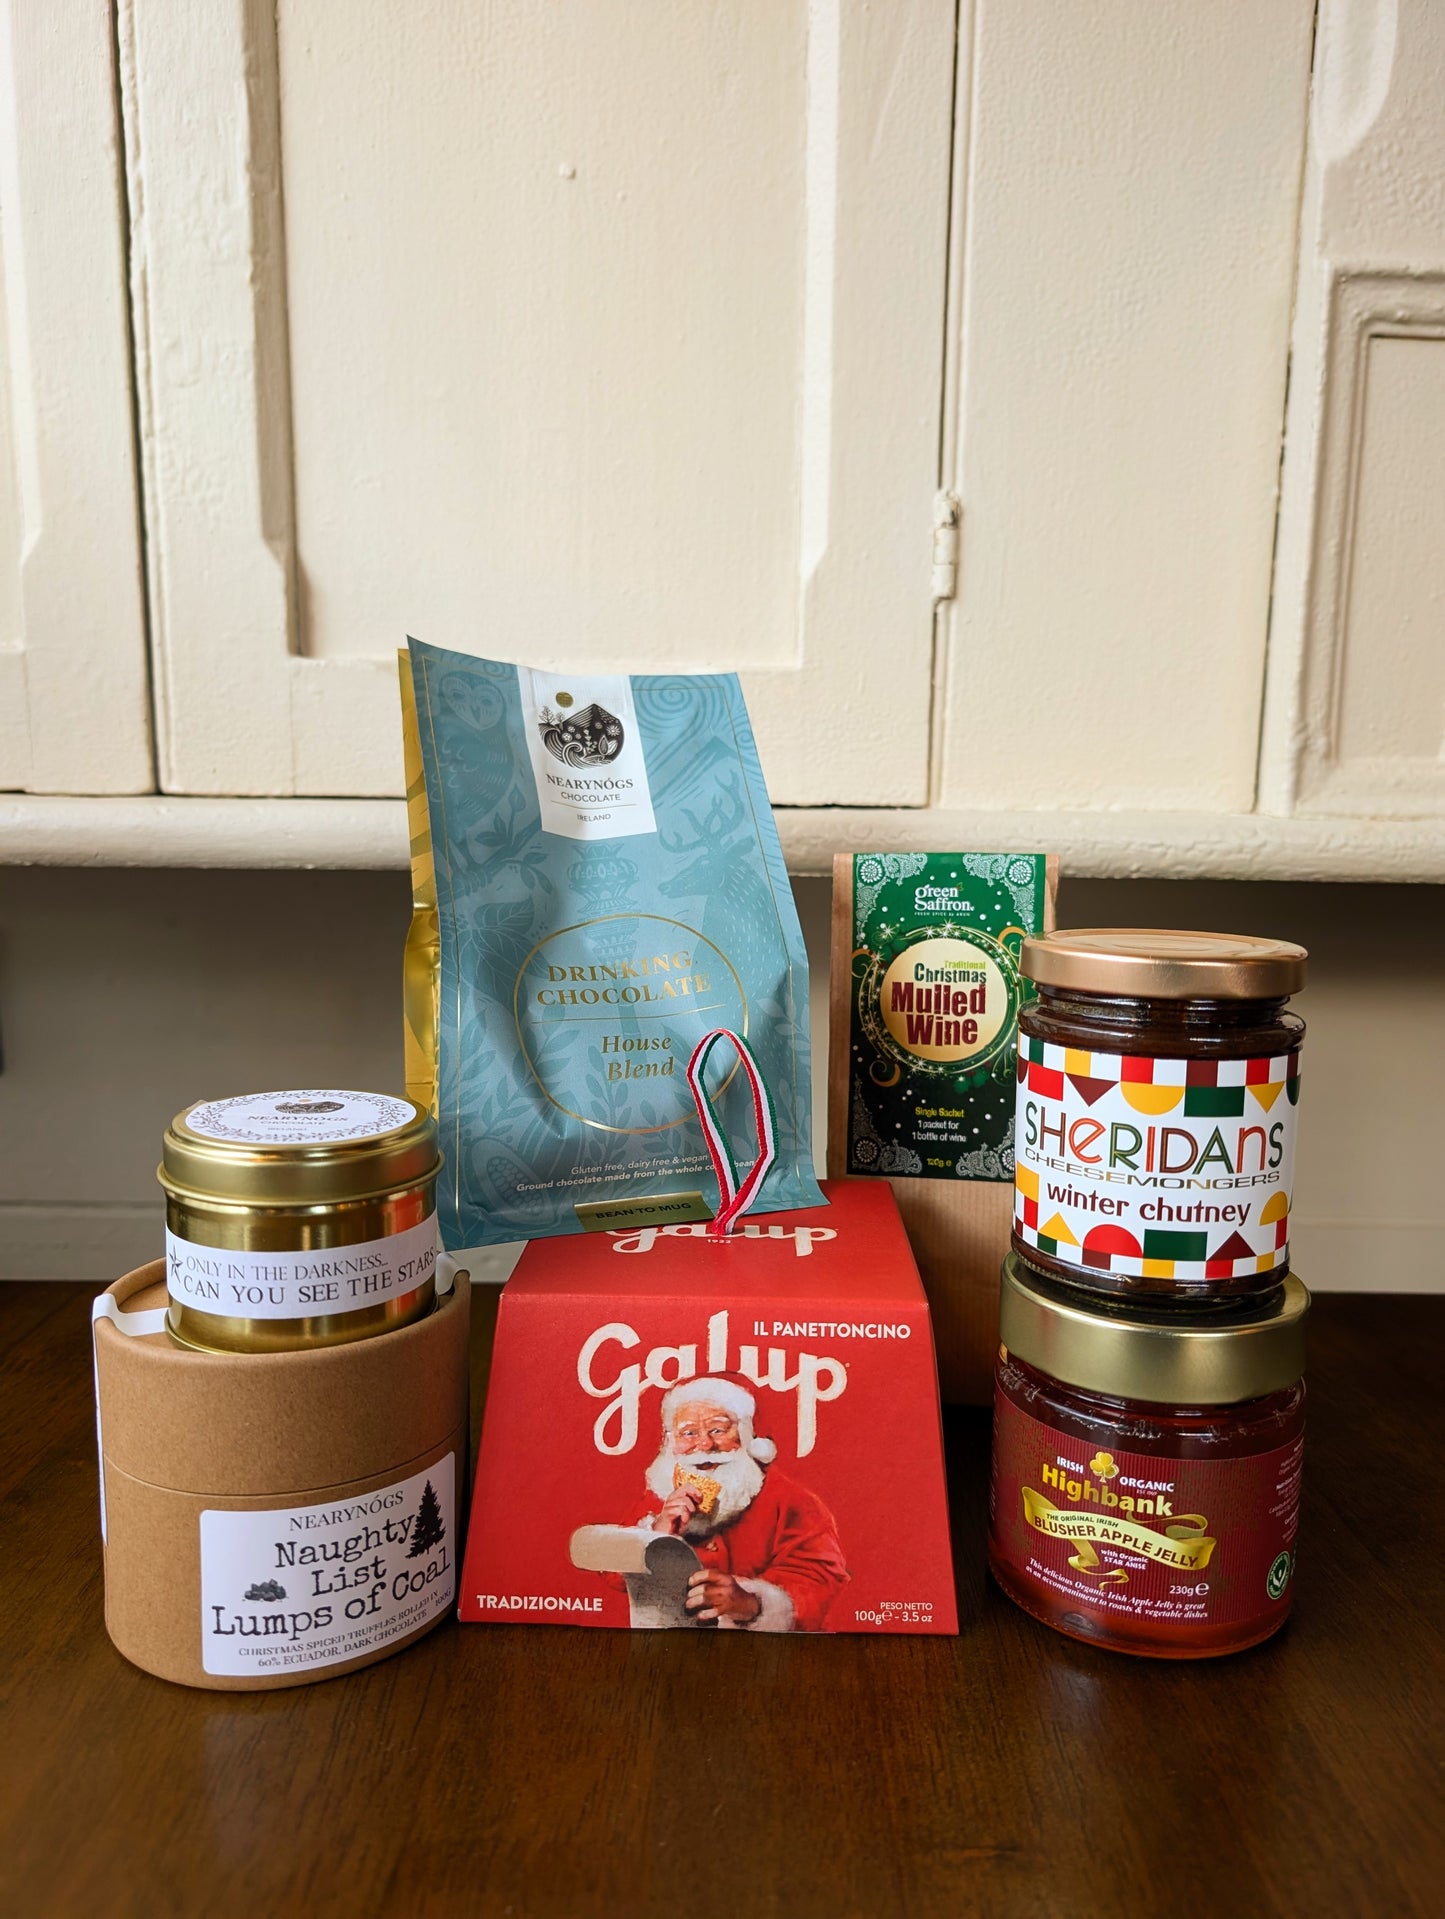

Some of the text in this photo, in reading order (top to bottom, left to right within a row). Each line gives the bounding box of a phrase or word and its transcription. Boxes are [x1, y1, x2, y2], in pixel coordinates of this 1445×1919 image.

[545, 773, 634, 791] NEARYNÓGS
[561, 791, 621, 803] CHOCOLATE
[576, 813, 612, 822] IRELAND
[914, 884, 959, 899] green
[547, 950, 692, 983] DRINKING
[914, 963, 987, 984] Christmas
[944, 960, 986, 969] Traditional
[537, 972, 712, 1007] CHOCOLATE
[891, 981, 986, 1017] Mulled
[906, 1014, 978, 1046] Wine
[601, 1033, 673, 1054] House
[607, 1056, 675, 1082] Blend
[915, 1106, 965, 1118] Single Sachet
[918, 1120, 960, 1129] 1 packet for
[912, 1131, 967, 1142] 1 bottle of wine
[571, 1155, 708, 1175] Gluten free, dairy free & vegan
[1025, 1147, 1280, 1189] CHEESEMONGERS
[516, 1180, 553, 1192] Ground
[556, 1175, 603, 1188] chocolate
[604, 1172, 631, 1181] made
[633, 1169, 656, 1179] from
[657, 1167, 674, 1177] the
[675, 1165, 704, 1175] whole
[596, 1202, 692, 1219] BEAN TO MUG
[1047, 1183, 1251, 1226] winter chutney
[183, 1247, 435, 1305] CAN YOU SEE THE STARS
[186, 1255, 222, 1279] ONLY
[228, 1264, 245, 1280] IN
[251, 1265, 288, 1281] THE
[753, 1321, 912, 1340] IL PANETTONCINO
[577, 1310, 848, 1458] Galup
[1057, 1456, 1175, 1492] IRISH ORGANIC
[1042, 1463, 1173, 1517] Highbank
[289, 1491, 404, 1531] NEARYNÓGS
[1046, 1513, 1119, 1527] THE ORIGINAL IRISH
[275, 1514, 415, 1568] Naughty
[1034, 1515, 1199, 1568] BLUSHER APPLE JELLY
[1101, 1549, 1149, 1563] with Organic
[1104, 1557, 1147, 1570] STAR ANISE
[311, 1555, 387, 1596] List
[1029, 1558, 1205, 1611] This delicious Organic Irish Apple Jelly is great
[212, 1546, 451, 1641] Lumps of Coal
[476, 1594, 603, 1612] TRADIZIONALE
[1025, 1565, 1033, 1573] as
[1033, 1569, 1042, 1578] an
[1041, 1575, 1098, 1604] accompaniment
[1098, 1598, 1107, 1606] to
[1108, 1601, 1133, 1612] roasts
[1134, 1607, 1142, 1615] &
[1144, 1608, 1183, 1619] vegetable
[880, 1602, 933, 1611] PESO NETTO
[902, 1611, 919, 1622] 3.5
[239, 1590, 439, 1656] CHRISTMAS SPICED TRUFFLES ROLLED IN
[258, 1658, 281, 1668] 60%
[284, 1648, 341, 1665] ECUADOR,
[344, 1638, 372, 1653] DARK
[374, 1609, 427, 1641] CHOCOLATE
